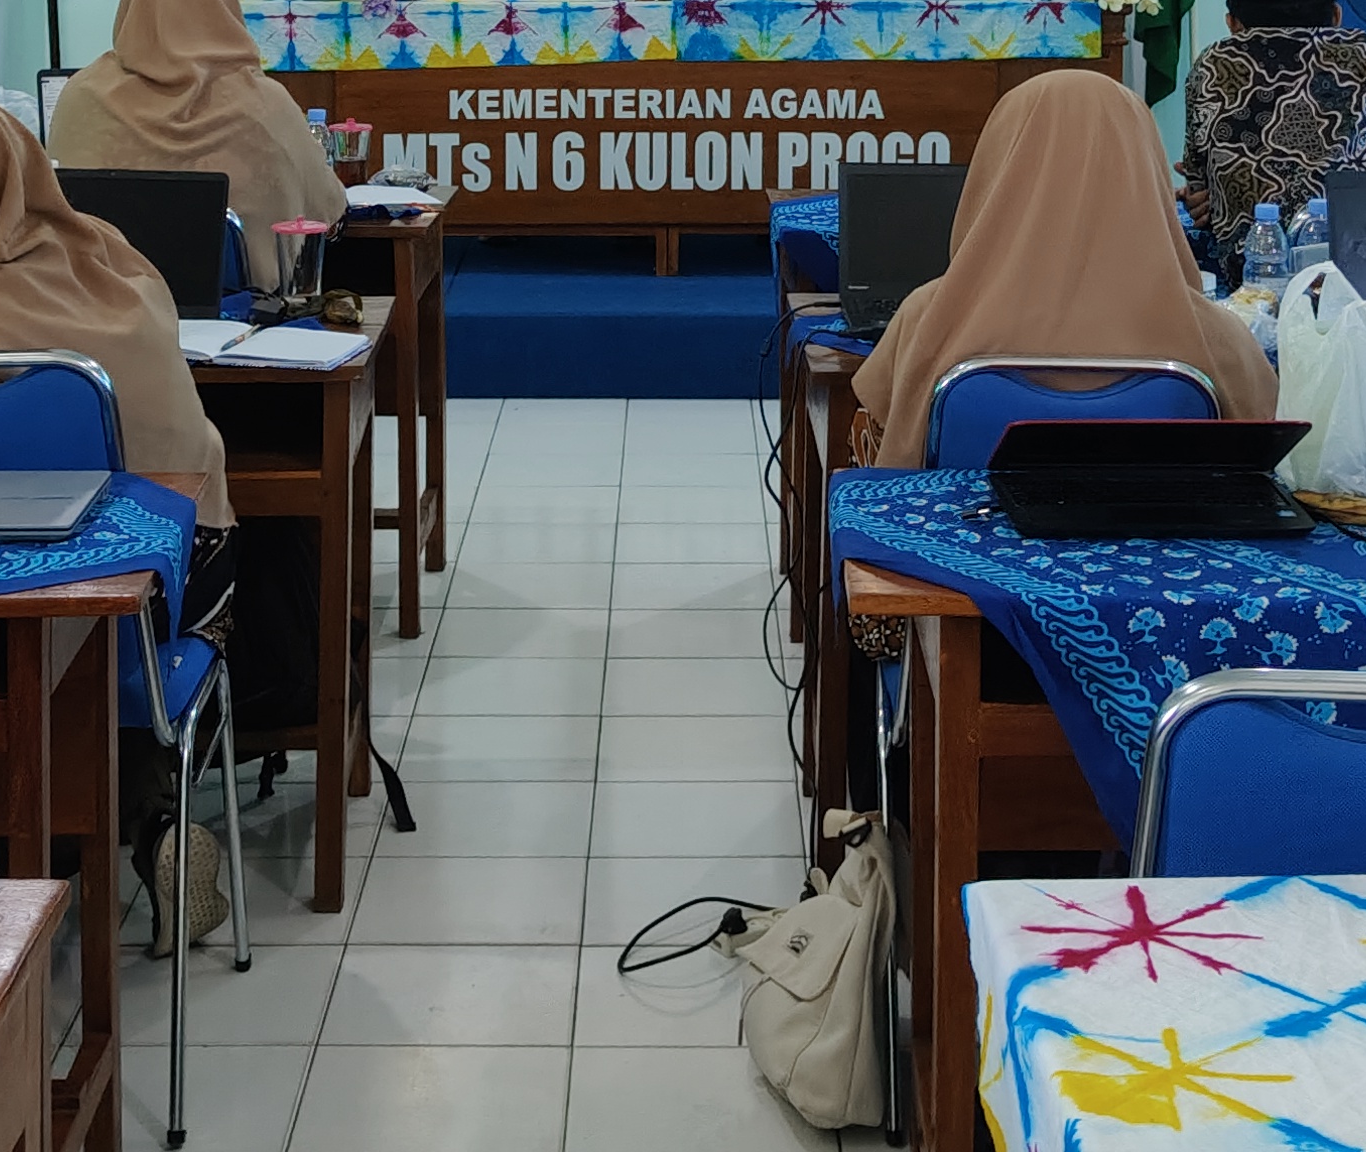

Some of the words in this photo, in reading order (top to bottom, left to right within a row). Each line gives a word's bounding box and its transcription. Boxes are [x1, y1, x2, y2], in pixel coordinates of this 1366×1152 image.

[449, 88, 731, 121] KEMENTERIAN
[744, 88, 885, 120] AGAMA
[383, 133, 492, 191] MTs
[506, 132, 538, 190] N
[553, 131, 586, 192] 6
[601, 132, 763, 191] KULON
